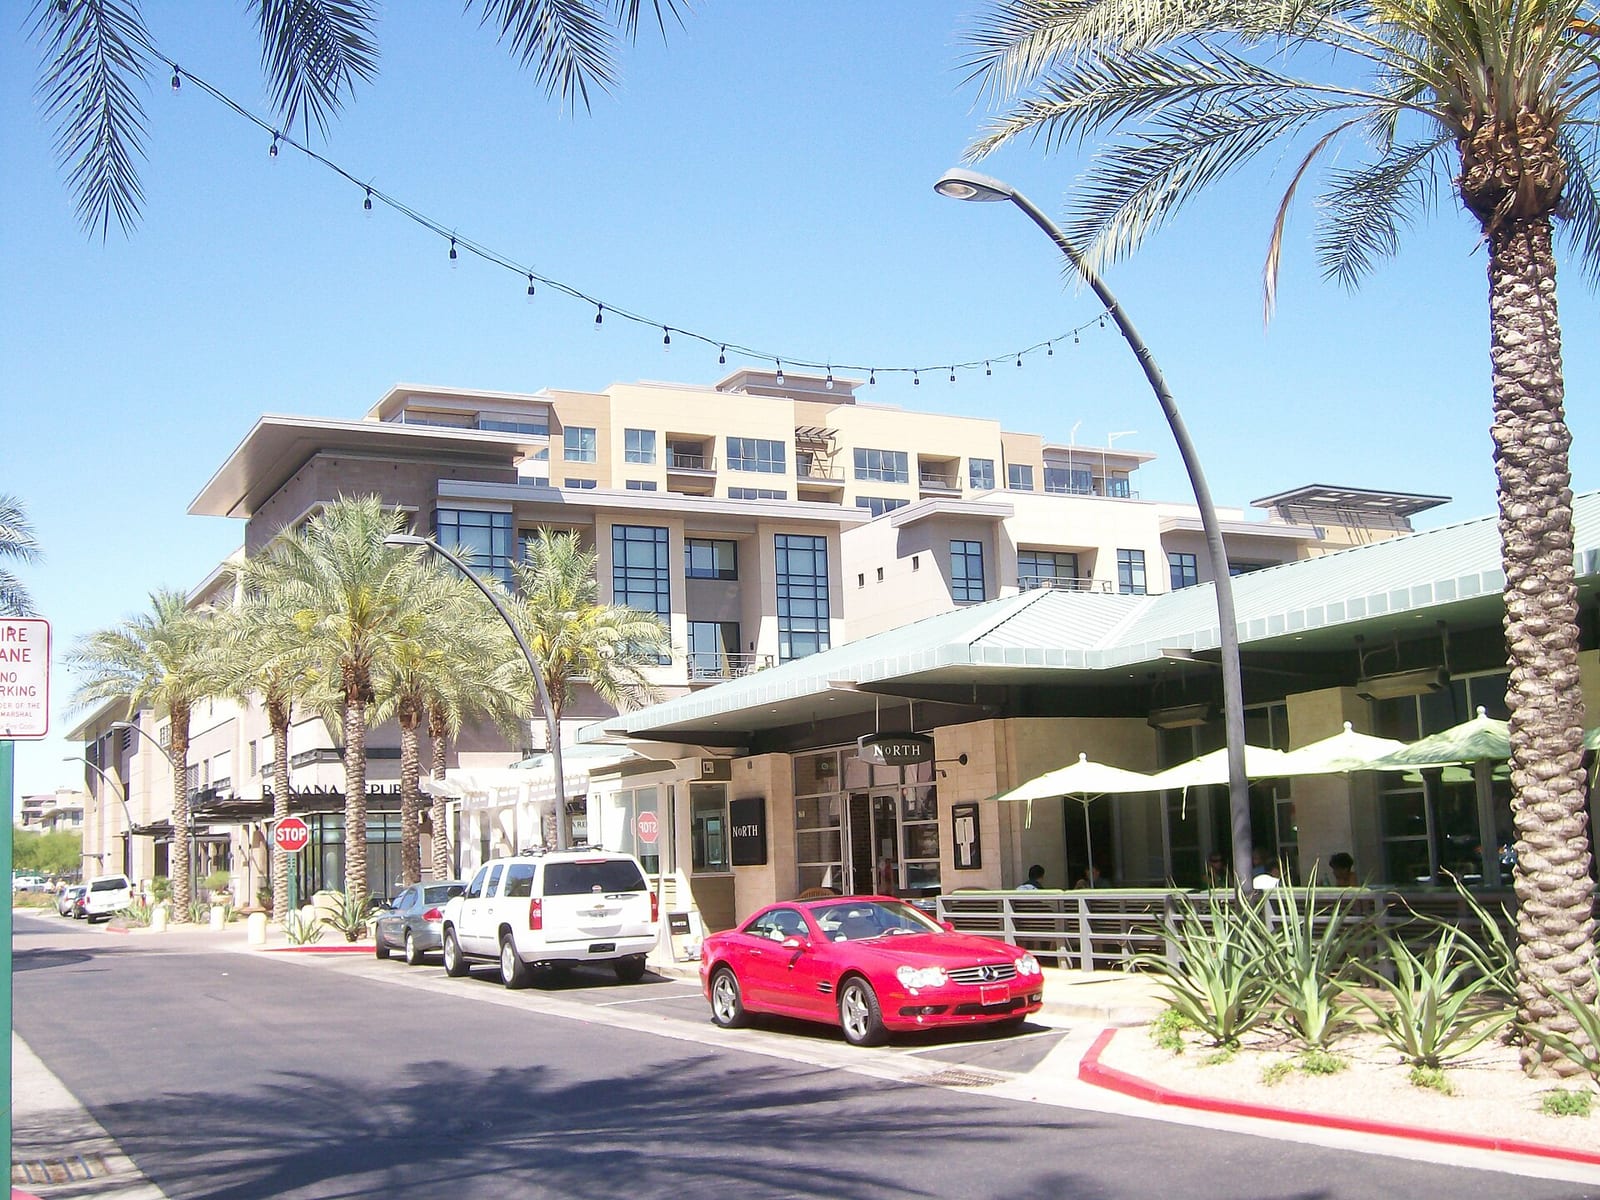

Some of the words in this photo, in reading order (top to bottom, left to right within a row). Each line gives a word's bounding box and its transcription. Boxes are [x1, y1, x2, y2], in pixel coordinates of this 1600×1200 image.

[0, 672, 17, 683] NO
[262, 784, 339, 796] BNANA
[276, 827, 307, 842] STOP
